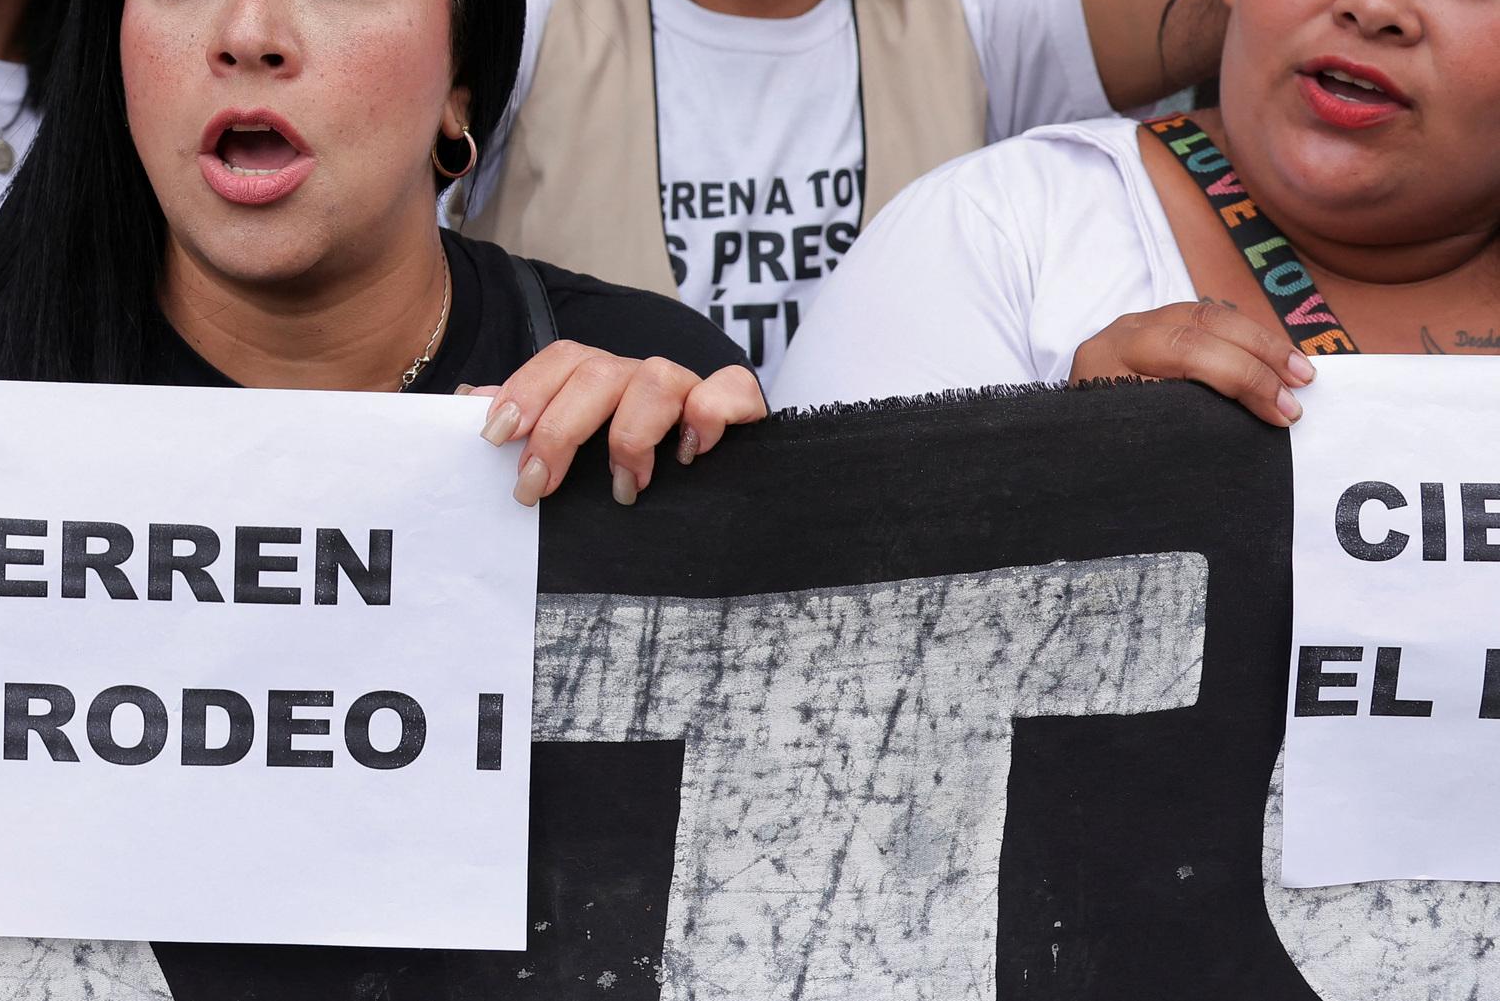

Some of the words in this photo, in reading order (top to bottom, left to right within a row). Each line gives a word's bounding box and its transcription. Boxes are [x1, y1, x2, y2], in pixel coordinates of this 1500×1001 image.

[765, 177, 795, 215] A
[1169, 132, 1258, 228] LOVE
[1244, 236, 1354, 356] LOVE
[1294, 645, 1433, 718] EL
[3, 683, 427, 770] RODEO
[476, 693, 504, 771] I
